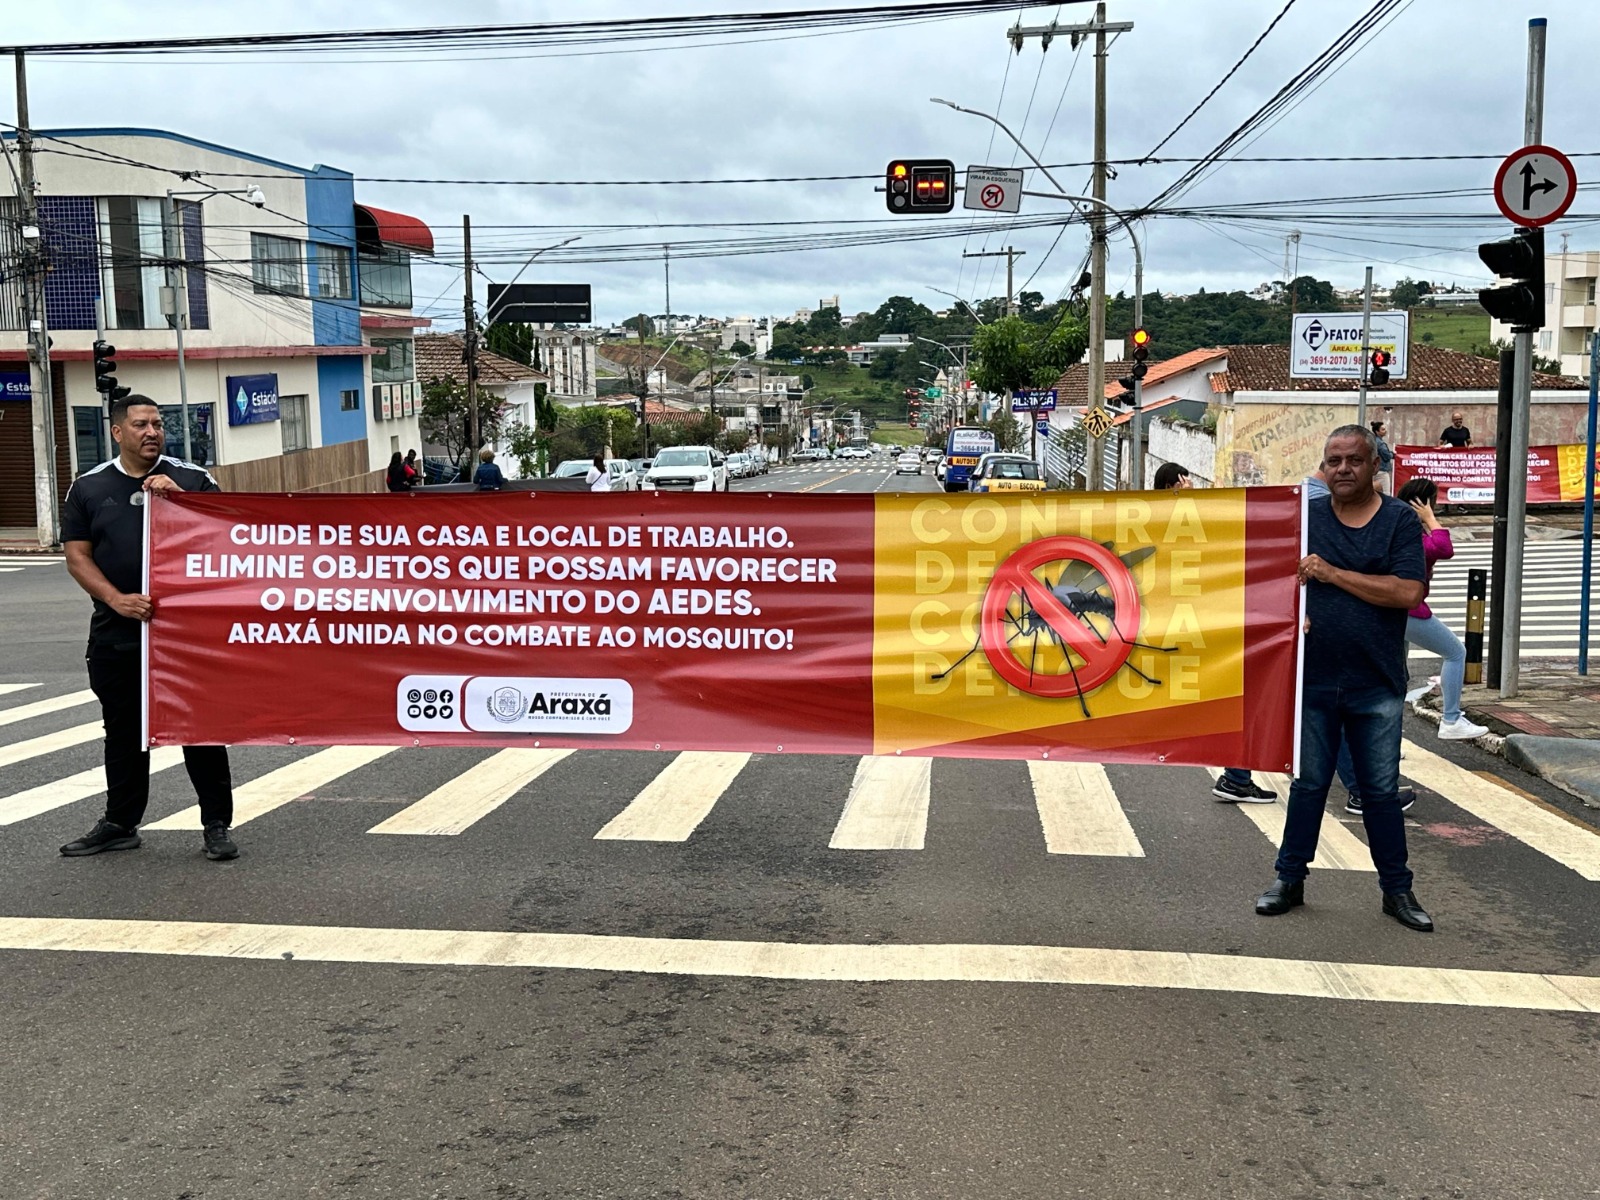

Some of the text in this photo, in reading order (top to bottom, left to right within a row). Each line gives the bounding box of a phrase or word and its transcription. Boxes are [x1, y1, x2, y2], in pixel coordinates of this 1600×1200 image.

[1310, 356, 1348, 365] 3691-2070
[252, 391, 277, 406] Estácio
[1320, 407, 1335, 424] 15
[1020, 482, 1040, 490] ESCOLA
[910, 497, 1209, 544] CONTRA
[230, 523, 795, 549] CUIDE DE SUA CASA E LOCAL DE TRABALHO.
[186, 553, 837, 583] ELIMINE OBJETOS QUE POSSAM FAVORECER
[260, 587, 762, 617] O DESENVOLVIMENTO DO AEDES.
[227, 618, 795, 651] ARAXÁ UNIDA NO COMBATE AO MOSQUITO!
[528, 692, 611, 715] Araxá
